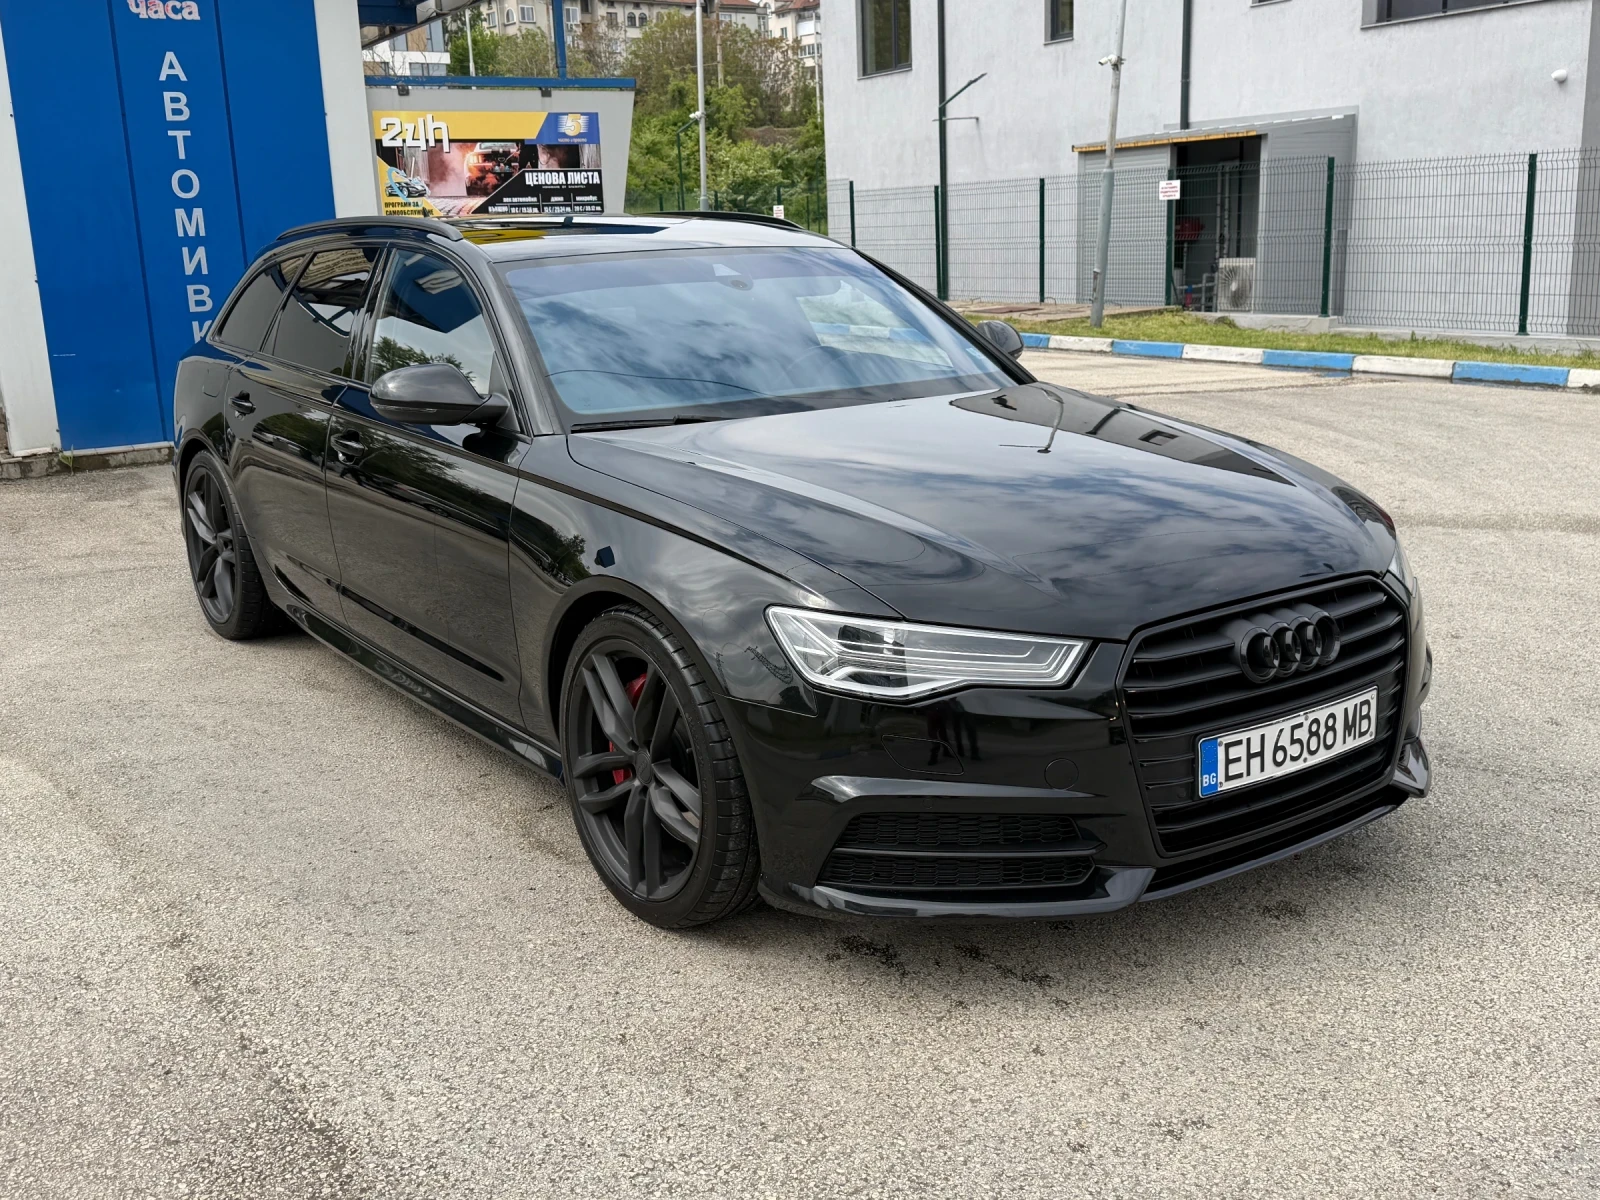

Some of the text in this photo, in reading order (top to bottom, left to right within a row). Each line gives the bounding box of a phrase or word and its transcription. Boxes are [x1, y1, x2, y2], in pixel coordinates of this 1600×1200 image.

[380, 114, 451, 154] 24h
[525, 171, 600, 186] ЦЕНОВА ЛИСТА
[1223, 698, 1372, 783] EH 6588 MB
[1202, 772, 1217, 787] BG
